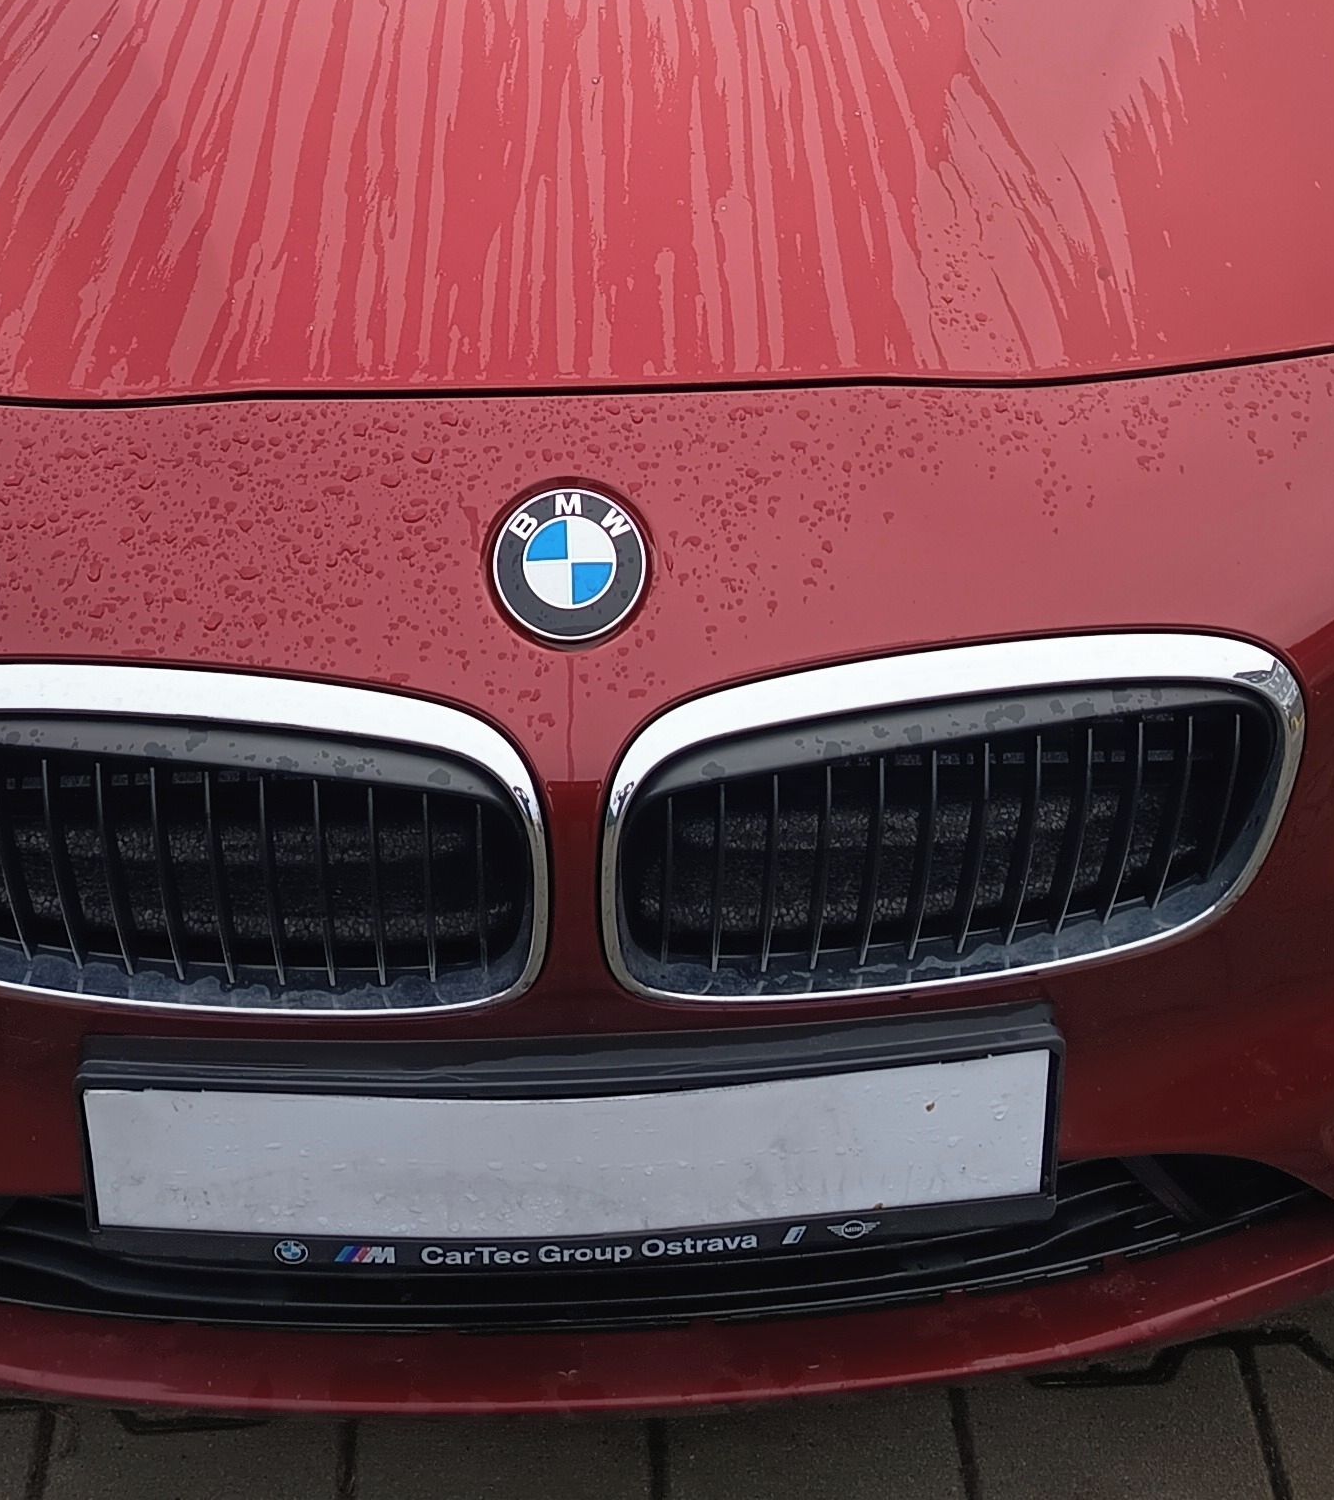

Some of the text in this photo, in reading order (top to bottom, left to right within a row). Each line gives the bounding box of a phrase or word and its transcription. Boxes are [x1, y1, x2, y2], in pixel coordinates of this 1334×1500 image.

[508, 493, 631, 541] BMW
[420, 1245, 530, 1265] CarTec
[538, 1243, 632, 1264] Group
[641, 1234, 758, 1258] Ostrava
